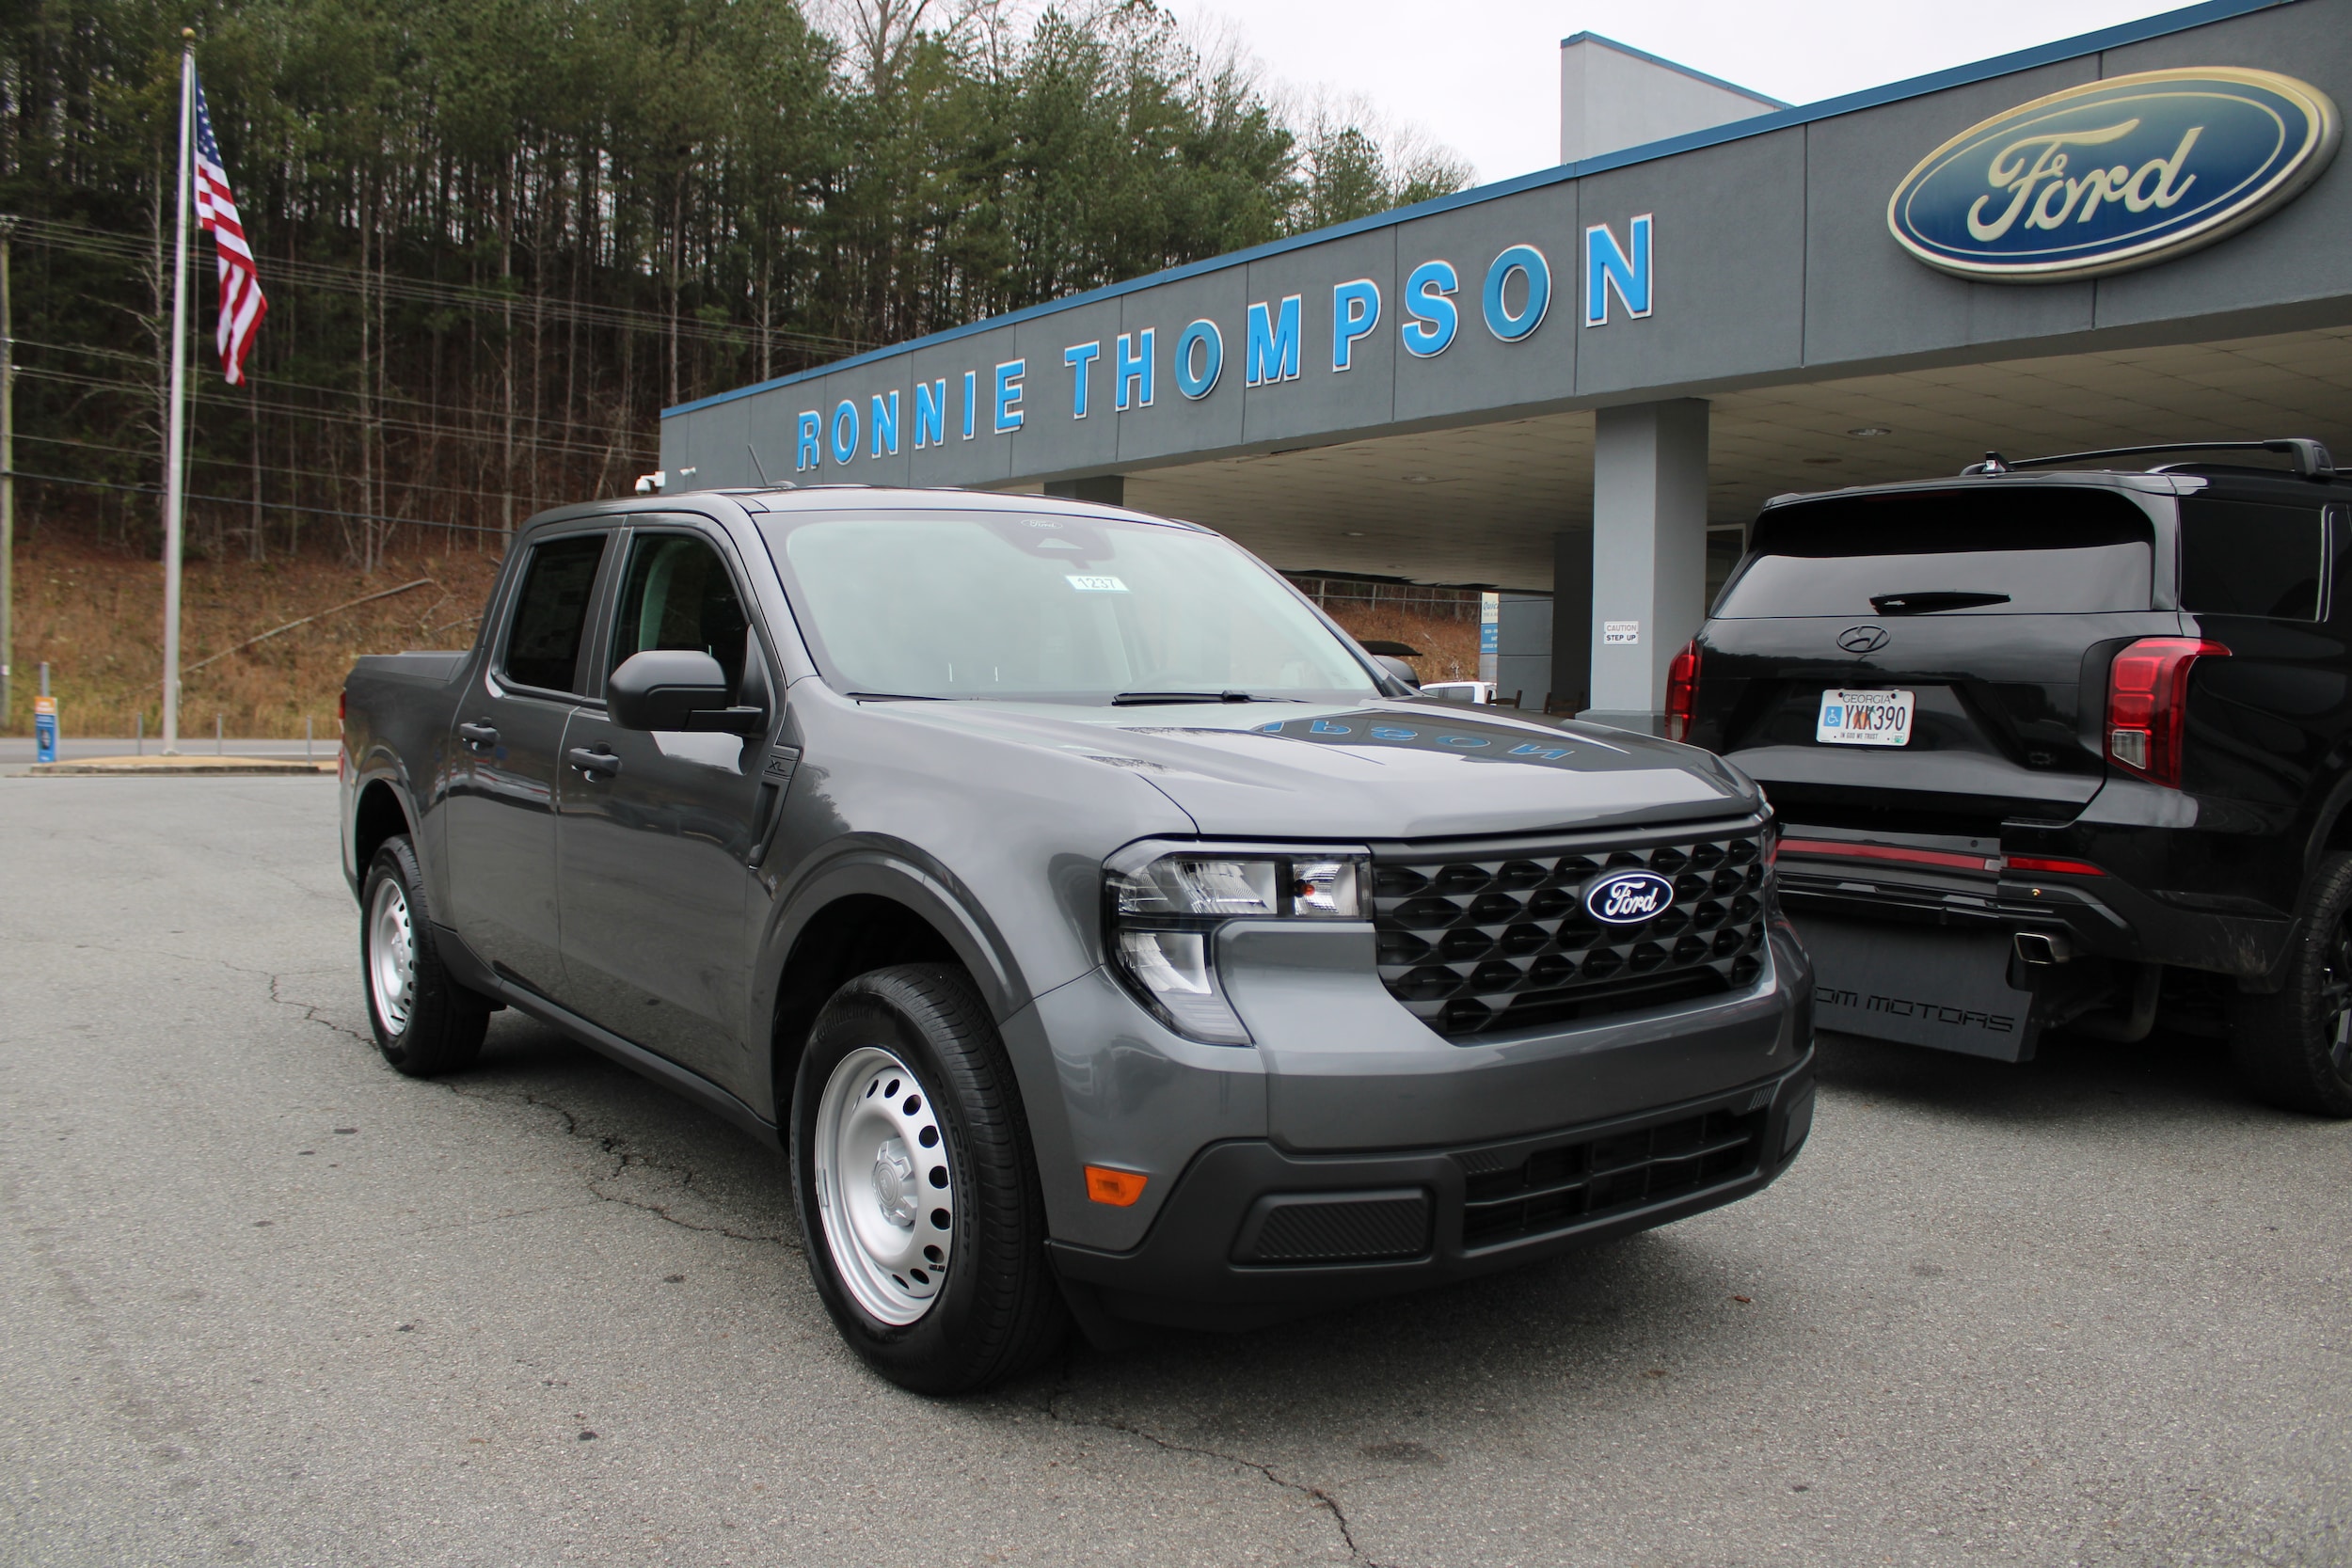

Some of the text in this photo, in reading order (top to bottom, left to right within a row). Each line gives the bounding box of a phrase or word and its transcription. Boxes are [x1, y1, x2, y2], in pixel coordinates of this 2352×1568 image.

[1966, 118, 2205, 243] Ford
[796, 212, 1654, 472] RONNIE THOMPSON
[1077, 577, 1116, 590] 1237
[1483, 601, 1499, 611] Quic
[1606, 624, 1637, 632] CAUTION
[1842, 694, 1891, 705] GEORGIA
[1845, 705, 1906, 732] YXK390
[768, 759, 786, 772] XL
[1604, 880, 1660, 916] Ford
[1866, 995, 2015, 1033] MOTORS
